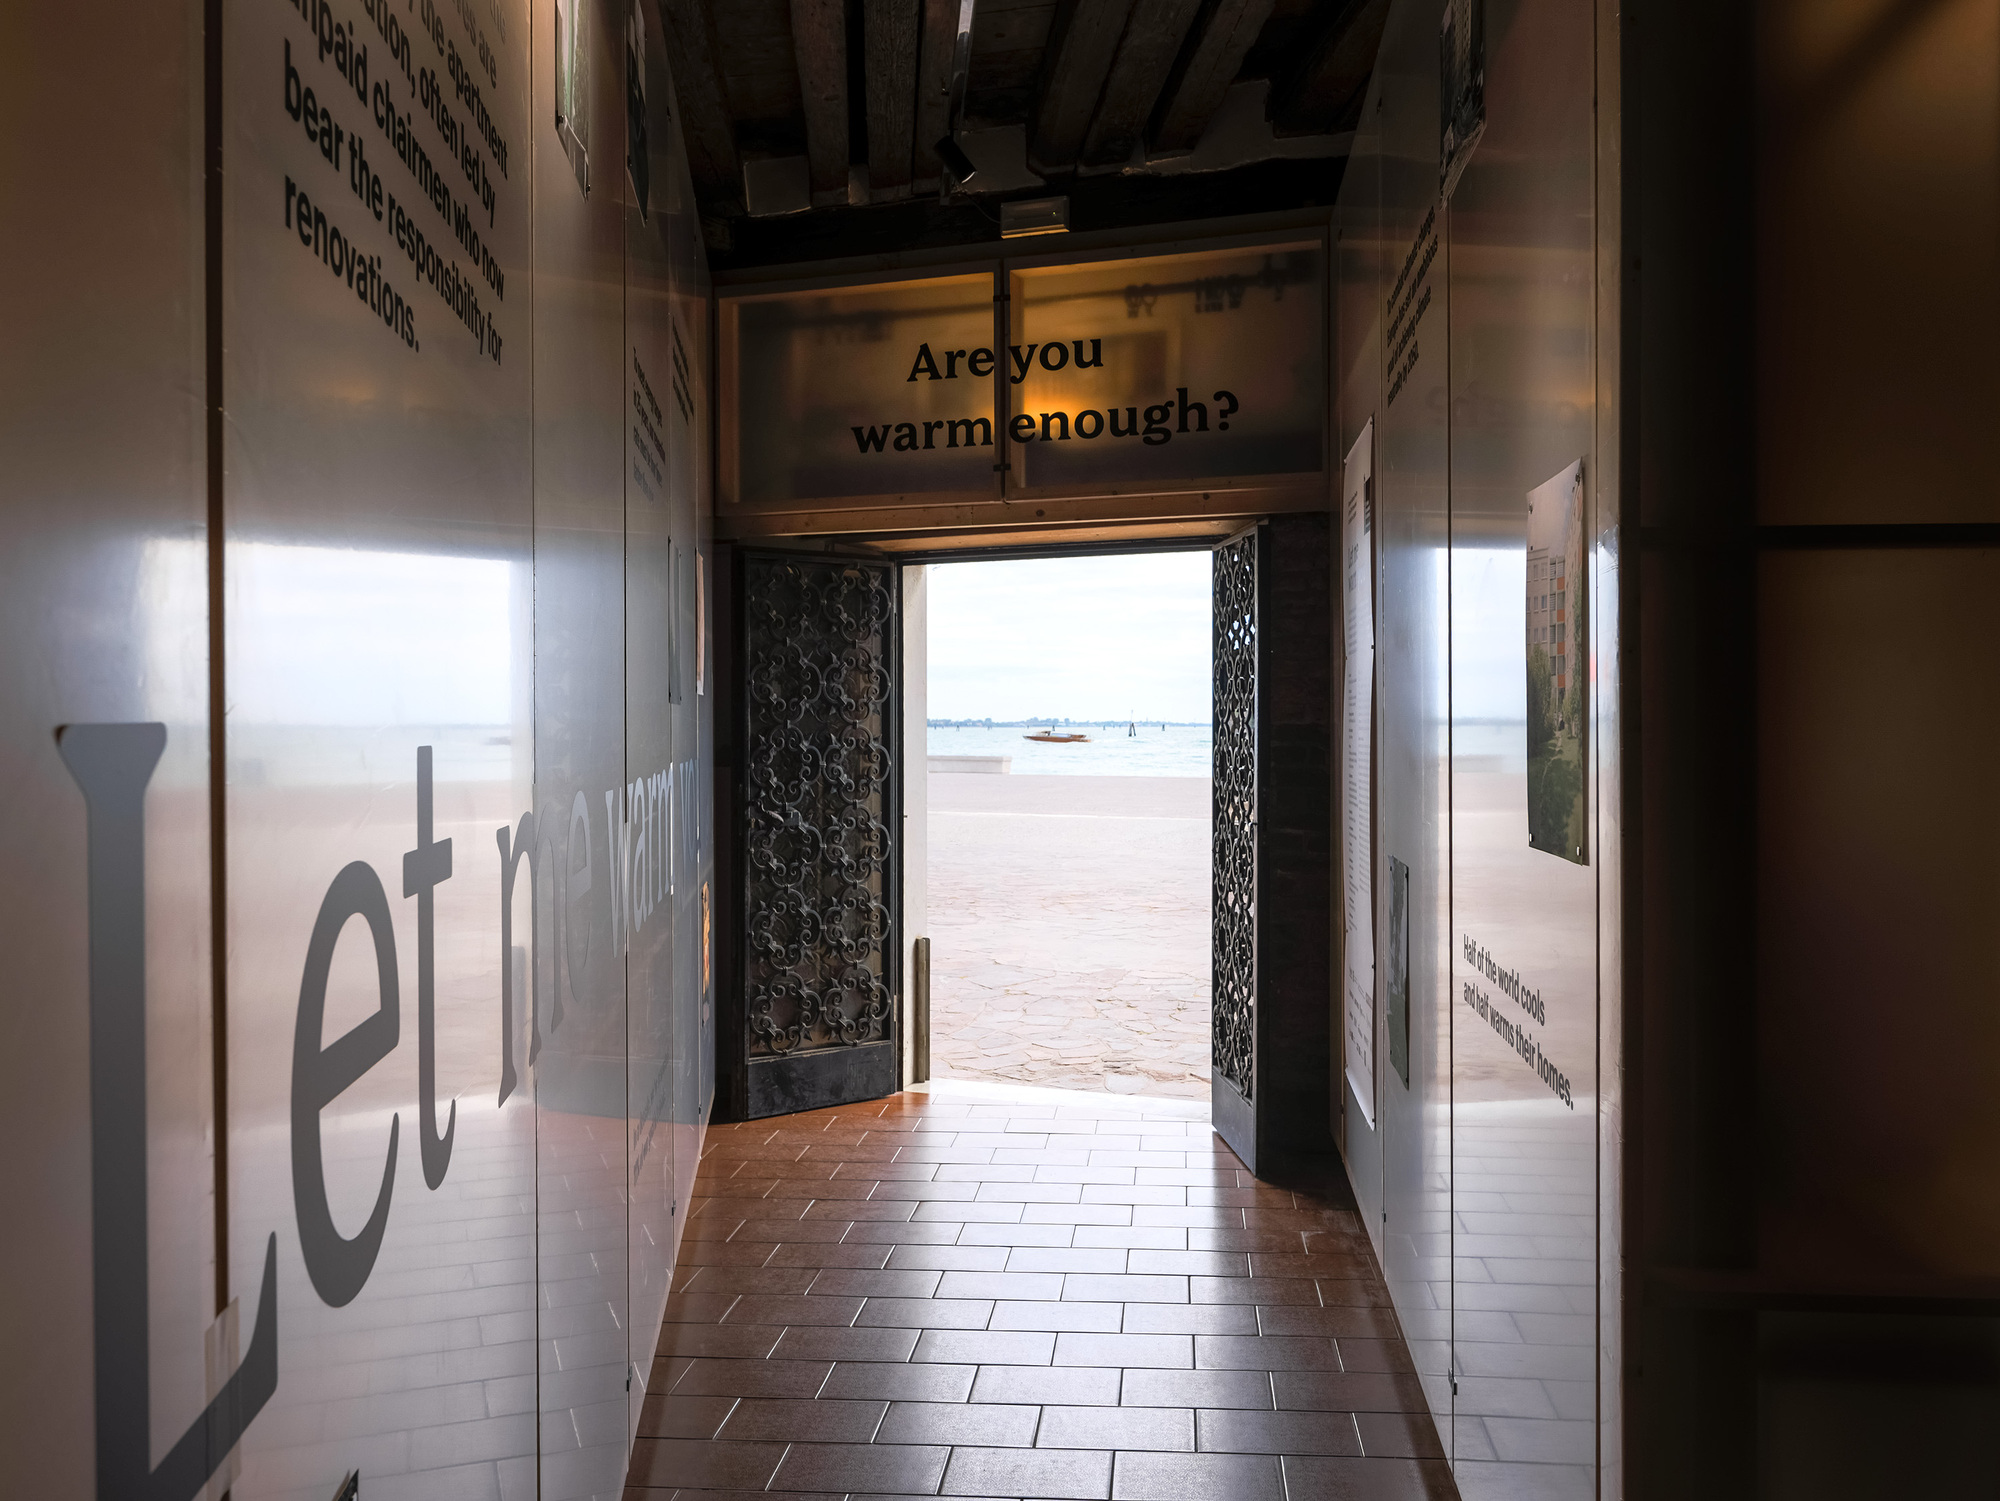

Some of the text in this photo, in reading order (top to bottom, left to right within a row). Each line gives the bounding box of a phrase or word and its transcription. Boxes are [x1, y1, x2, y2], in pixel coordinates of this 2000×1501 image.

[448, 39, 508, 180] apartment
[479, 30, 496, 89] are
[285, 37, 502, 366] bear the responsibility for
[373, 79, 451, 227] chairmen
[454, 200, 480, 266] who
[483, 244, 504, 302] now
[420, 67, 458, 160] often
[461, 122, 480, 196] led
[482, 160, 496, 229] by
[285, 175, 419, 353] renovations.
[851, 387, 1240, 454] warm enough?
[907, 338, 1104, 385] Are you
[1463, 934, 1545, 1026] Half of the world cools
[1463, 982, 1574, 1111] and half warms their homes.
[52, 720, 456, 1501] Let
[495, 790, 592, 1110] me
[605, 761, 675, 959] warm
